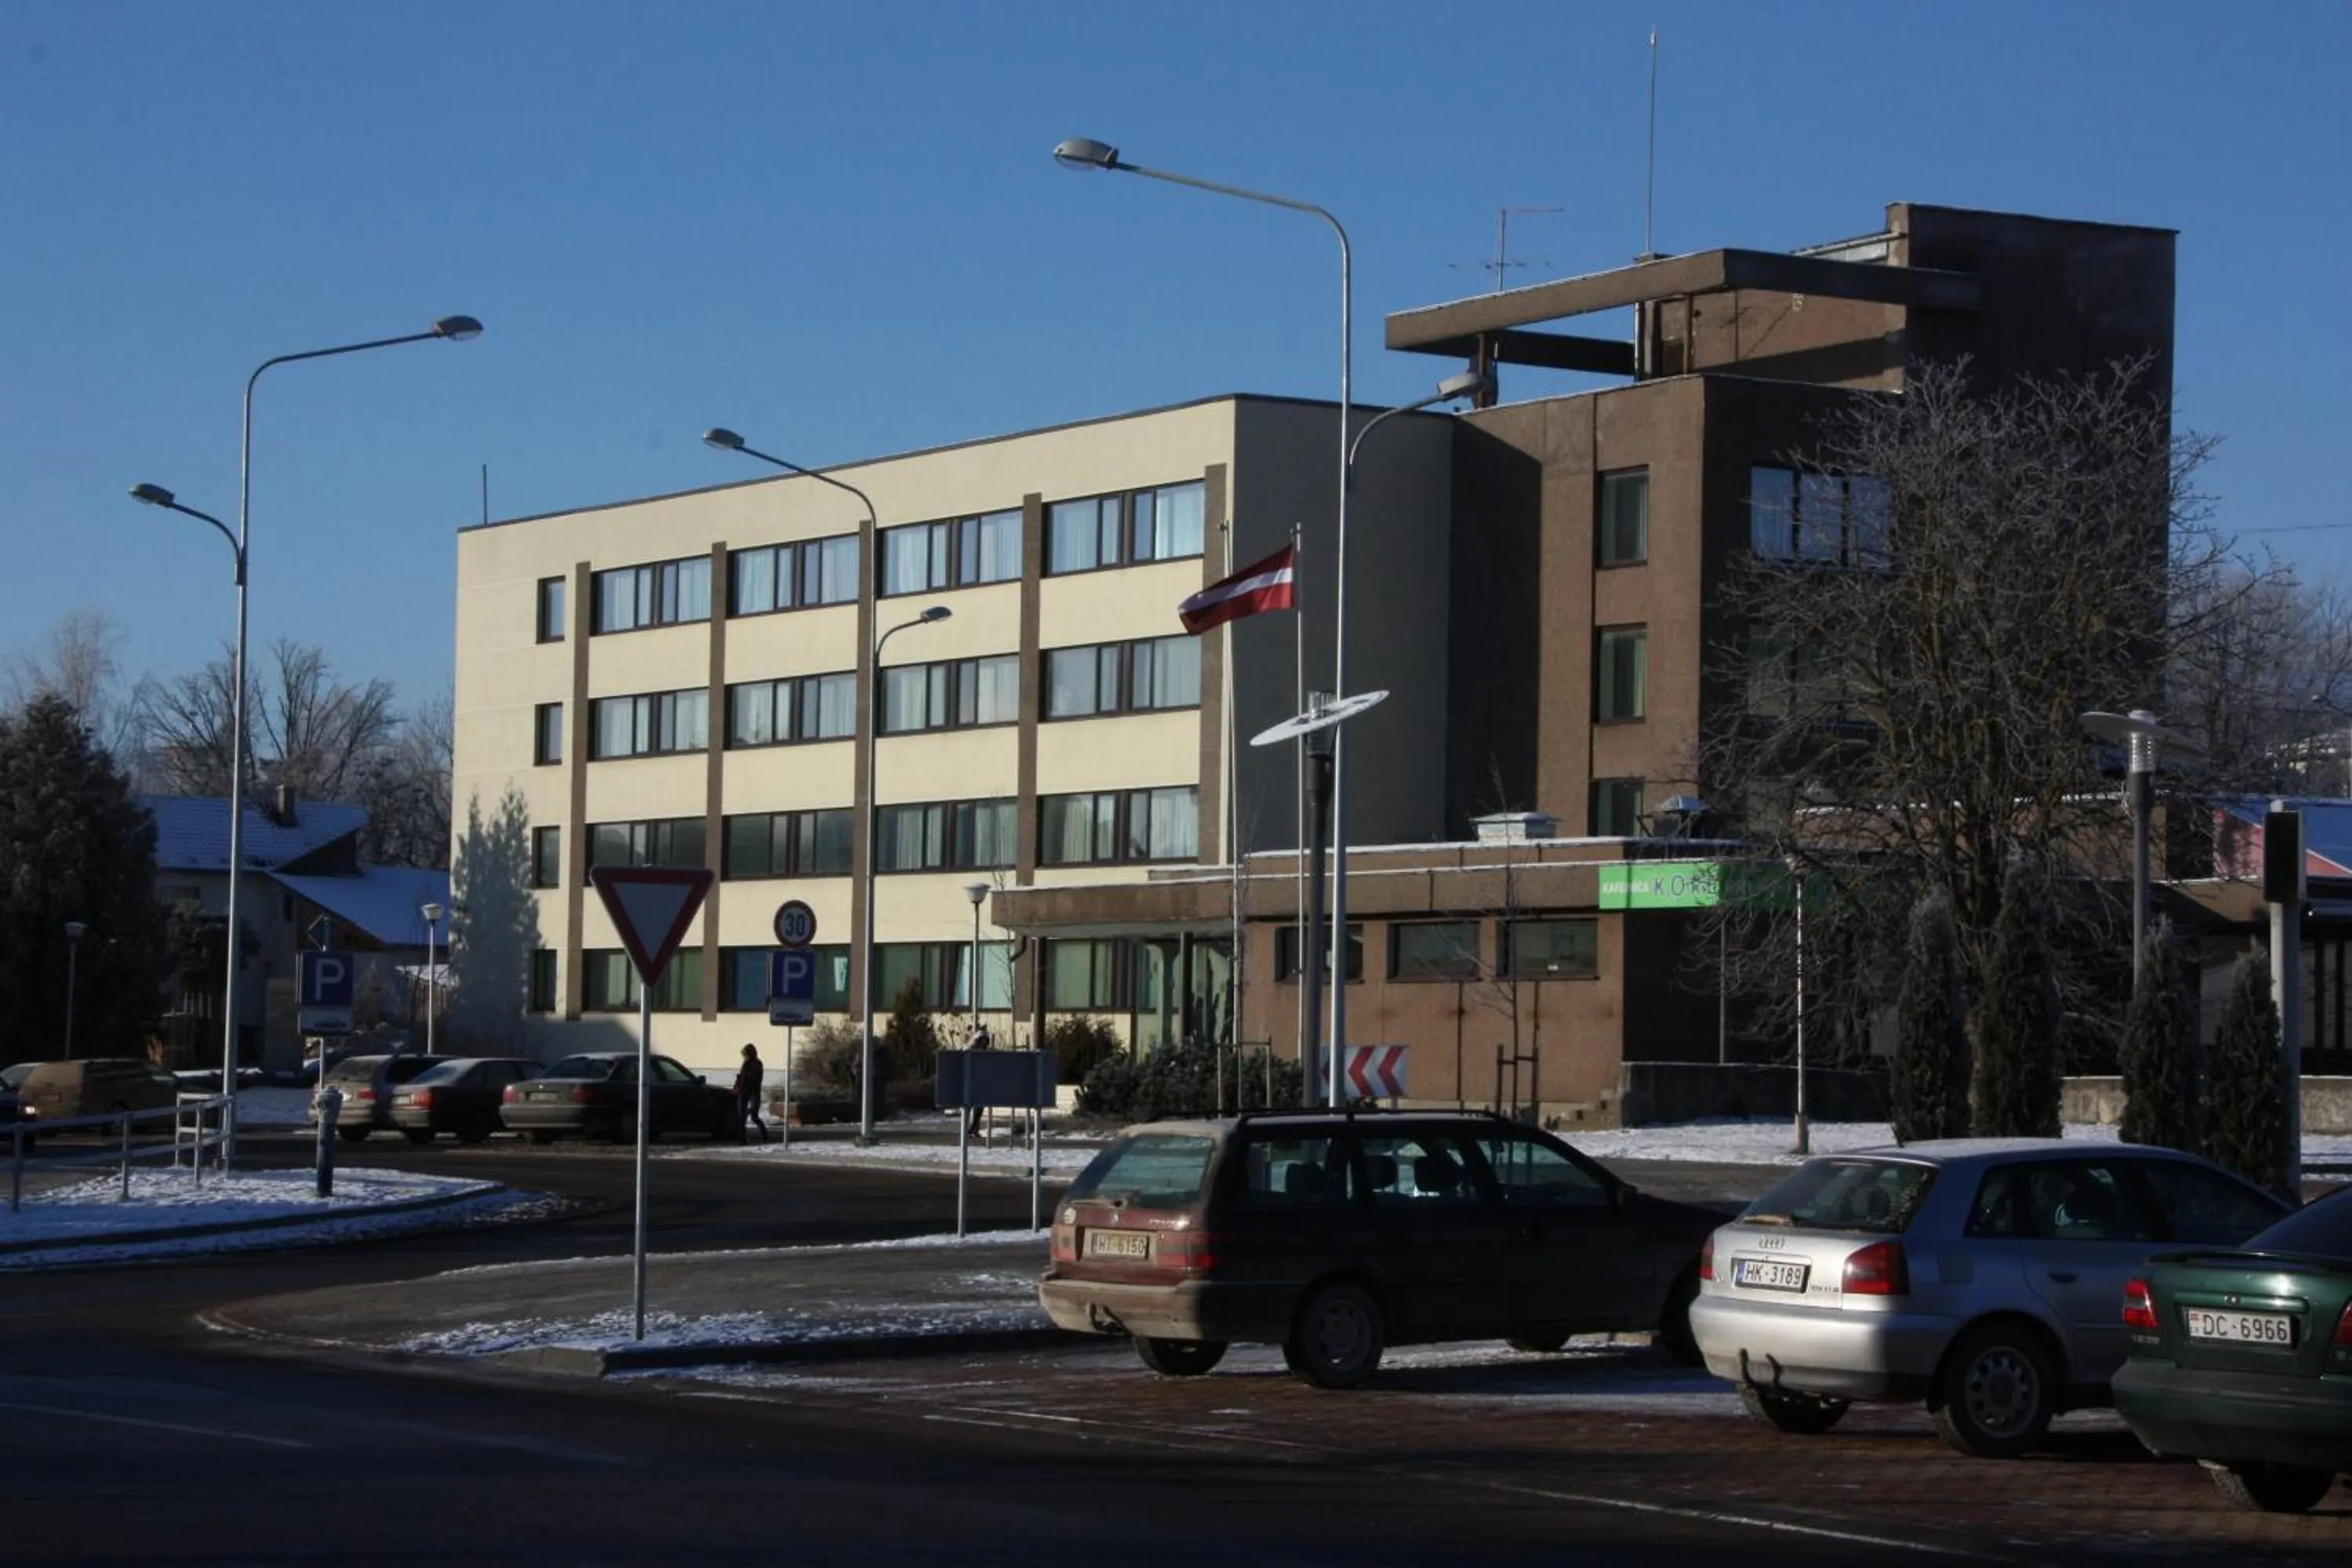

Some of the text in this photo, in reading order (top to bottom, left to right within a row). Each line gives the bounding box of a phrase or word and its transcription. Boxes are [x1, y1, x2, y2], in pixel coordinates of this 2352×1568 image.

[785, 913, 805, 936] 30
[315, 958, 345, 1002] P
[782, 956, 808, 994] P
[1745, 1263, 1802, 1285] HK-3189
[2202, 1314, 2287, 1341] DC-6966
